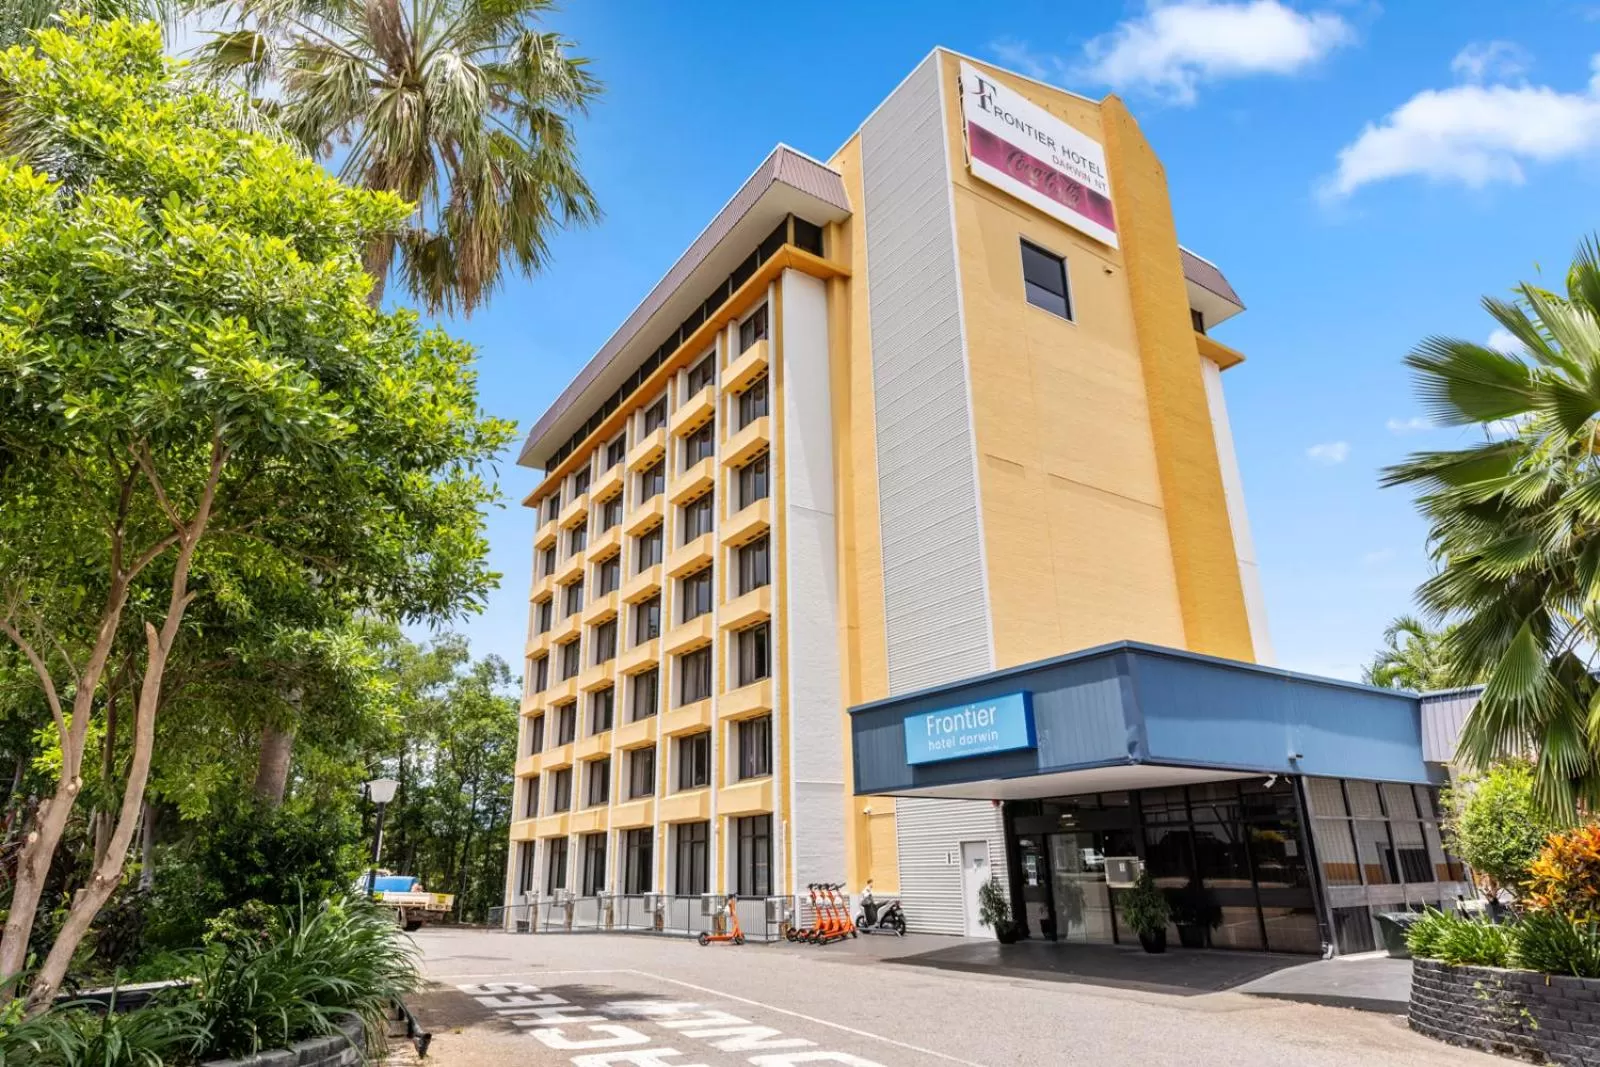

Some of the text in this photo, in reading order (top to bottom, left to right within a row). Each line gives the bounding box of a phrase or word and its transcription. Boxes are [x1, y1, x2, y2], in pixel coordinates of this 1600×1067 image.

[971, 75, 1104, 179] FRONTIER HOTEL
[1052, 154, 1091, 182] DARWIN
[926, 705, 996, 737] Frontier
[928, 735, 956, 752] hotel
[959, 729, 998, 746] darwin
